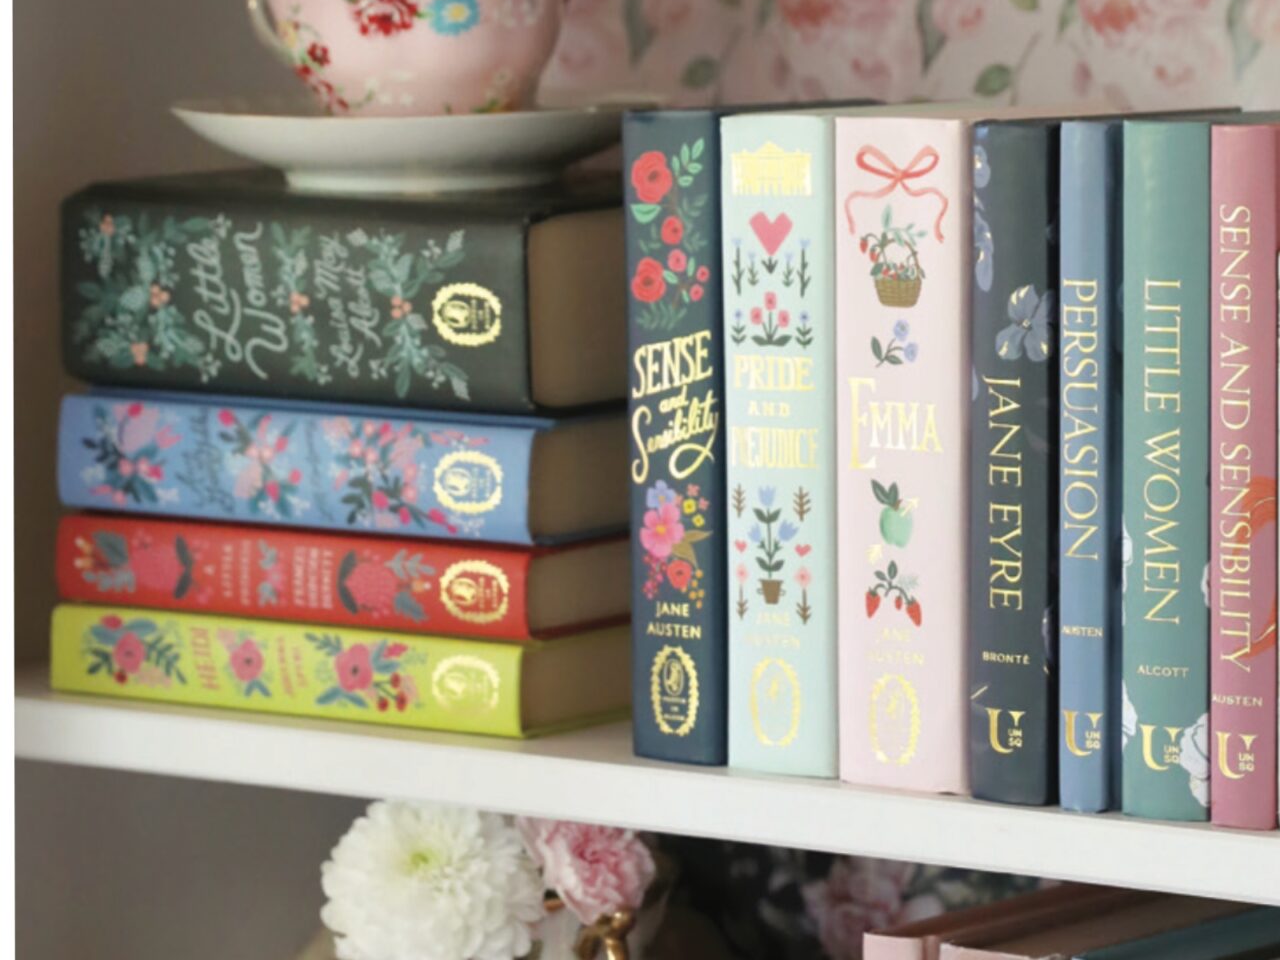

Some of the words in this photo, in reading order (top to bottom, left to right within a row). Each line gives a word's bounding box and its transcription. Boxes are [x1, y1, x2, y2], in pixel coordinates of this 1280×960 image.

[187, 233, 243, 361] Little
[233, 222, 289, 380] Women
[349, 265, 381, 347] Alcott
[1220, 203, 1251, 324] SENSE
[632, 330, 713, 399] SENSE
[733, 354, 816, 392] PRIDE
[1144, 278, 1181, 413] LITTLE
[1220, 333, 1251, 431] AND
[631, 390, 719, 484] Sensibility
[659, 384, 688, 413] and
[747, 400, 791, 417] AND
[982, 374, 1022, 487] JANE
[1063, 278, 1098, 560] PERSUASION
[989, 502, 1023, 611] EYRE
[1144, 428, 1181, 624] WOMEN
[1220, 443, 1251, 673] SENSIBILITY
[647, 622, 702, 639] AUSTEN
[656, 601, 690, 617] JANE
[1061, 625, 1103, 638] AUSTEN
[1137, 664, 1189, 678] ALCOTT
[1211, 692, 1263, 707] AUSTEN
